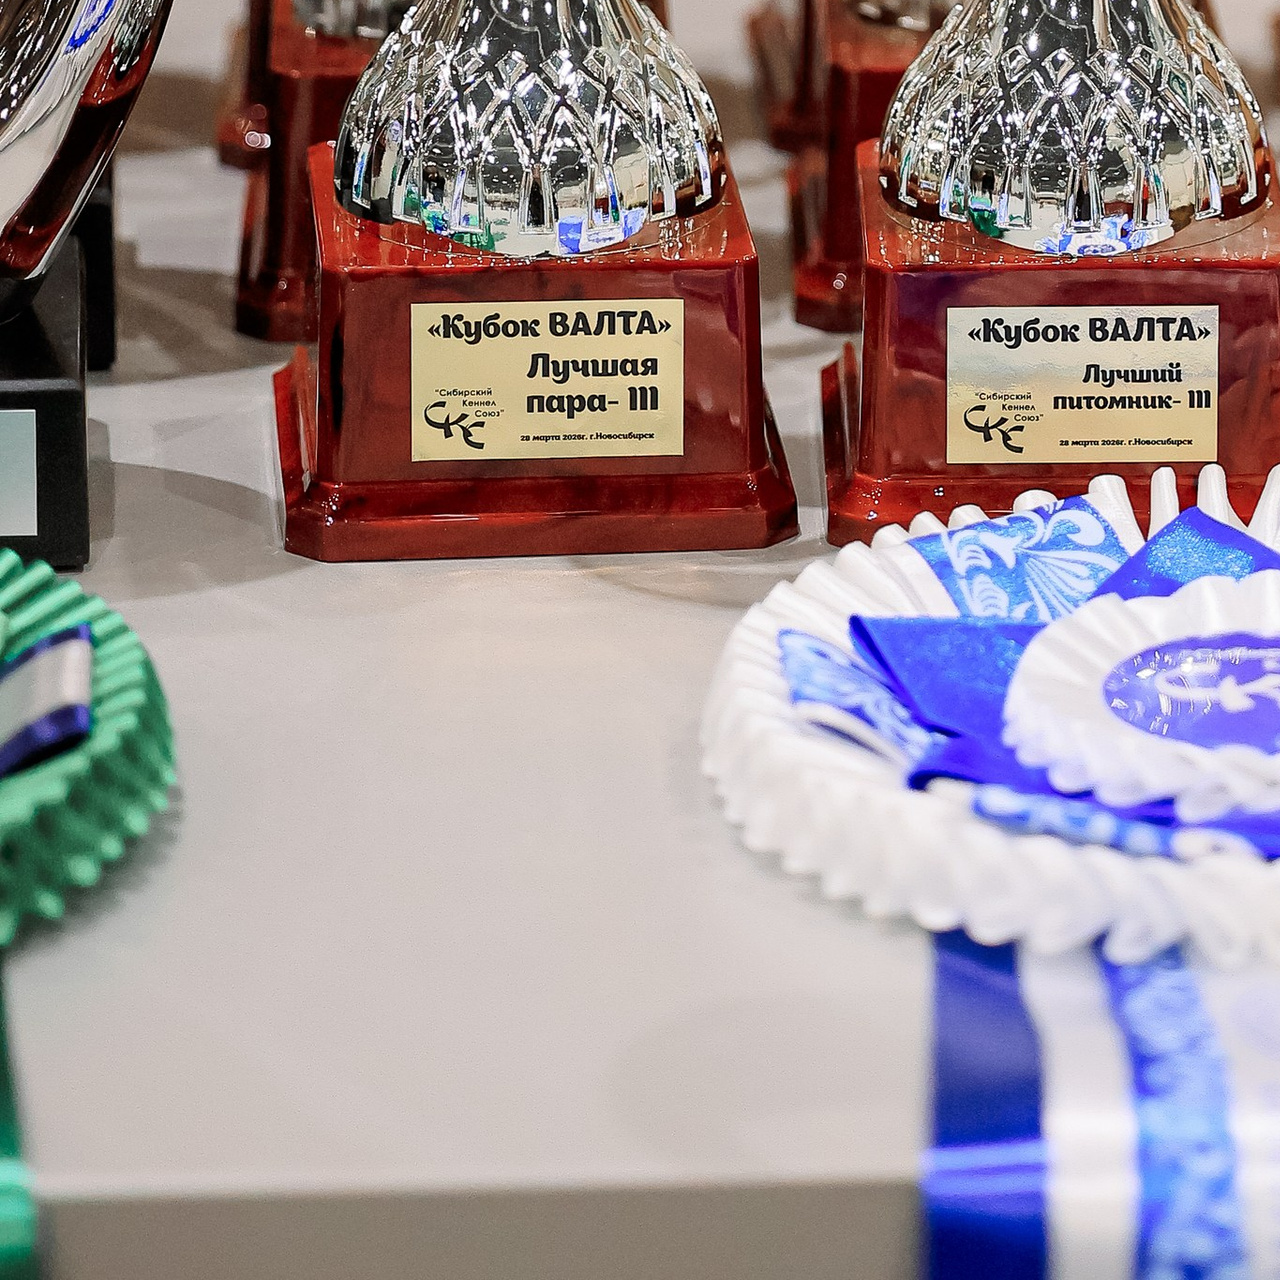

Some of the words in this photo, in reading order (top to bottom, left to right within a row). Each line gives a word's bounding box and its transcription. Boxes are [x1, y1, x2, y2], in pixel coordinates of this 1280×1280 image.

[428, 312, 540, 344] «Кубок
[549, 310, 672, 336] ВАЛТА»
[968, 318, 1080, 349] «Кубок
[1089, 317, 1210, 341] ВАЛТА»
[526, 353, 658, 384] Лучшая
[1083, 362, 1182, 387] Лучший
[435, 388, 492, 397] "Сибирский
[628, 386, 658, 410] III
[975, 392, 1032, 402] "Сибирский
[1188, 390, 1211, 408] III
[474, 410, 504, 418] Союз"
[1014, 414, 1043, 422] Союз"
[532, 434, 560, 442] марта
[590, 431, 654, 440] г.Новосибирск
[1072, 440, 1099, 448] марта
[1128, 438, 1192, 447] г.Новосибирск
